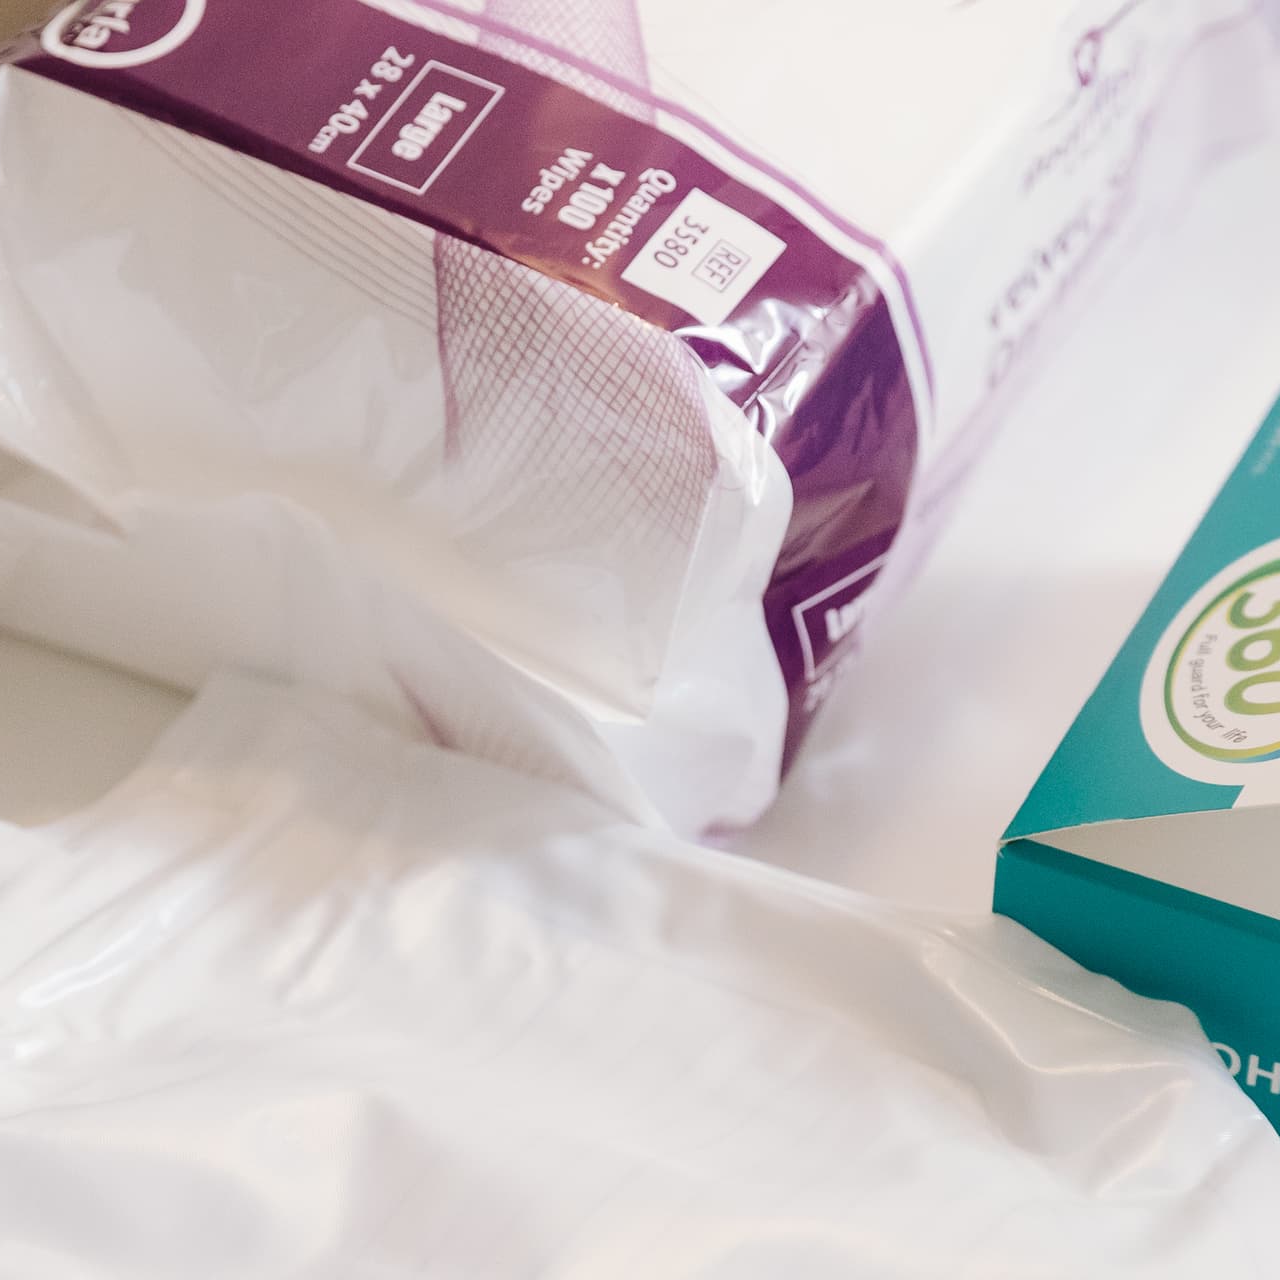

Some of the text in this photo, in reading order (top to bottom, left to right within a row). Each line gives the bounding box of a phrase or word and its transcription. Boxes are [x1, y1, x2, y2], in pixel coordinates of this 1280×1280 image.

[307, 46, 416, 153] 28 x 40cm
[521, 147, 594, 216] Wipes
[556, 182, 615, 231] 100
[580, 167, 678, 270] Quantity:
[653, 215, 710, 269] 3580
[704, 246, 743, 286] REF
[1188, 658, 1209, 693] guard
[1192, 692, 1210, 709] for
[1192, 710, 1225, 730] your
[1222, 727, 1248, 744] life
